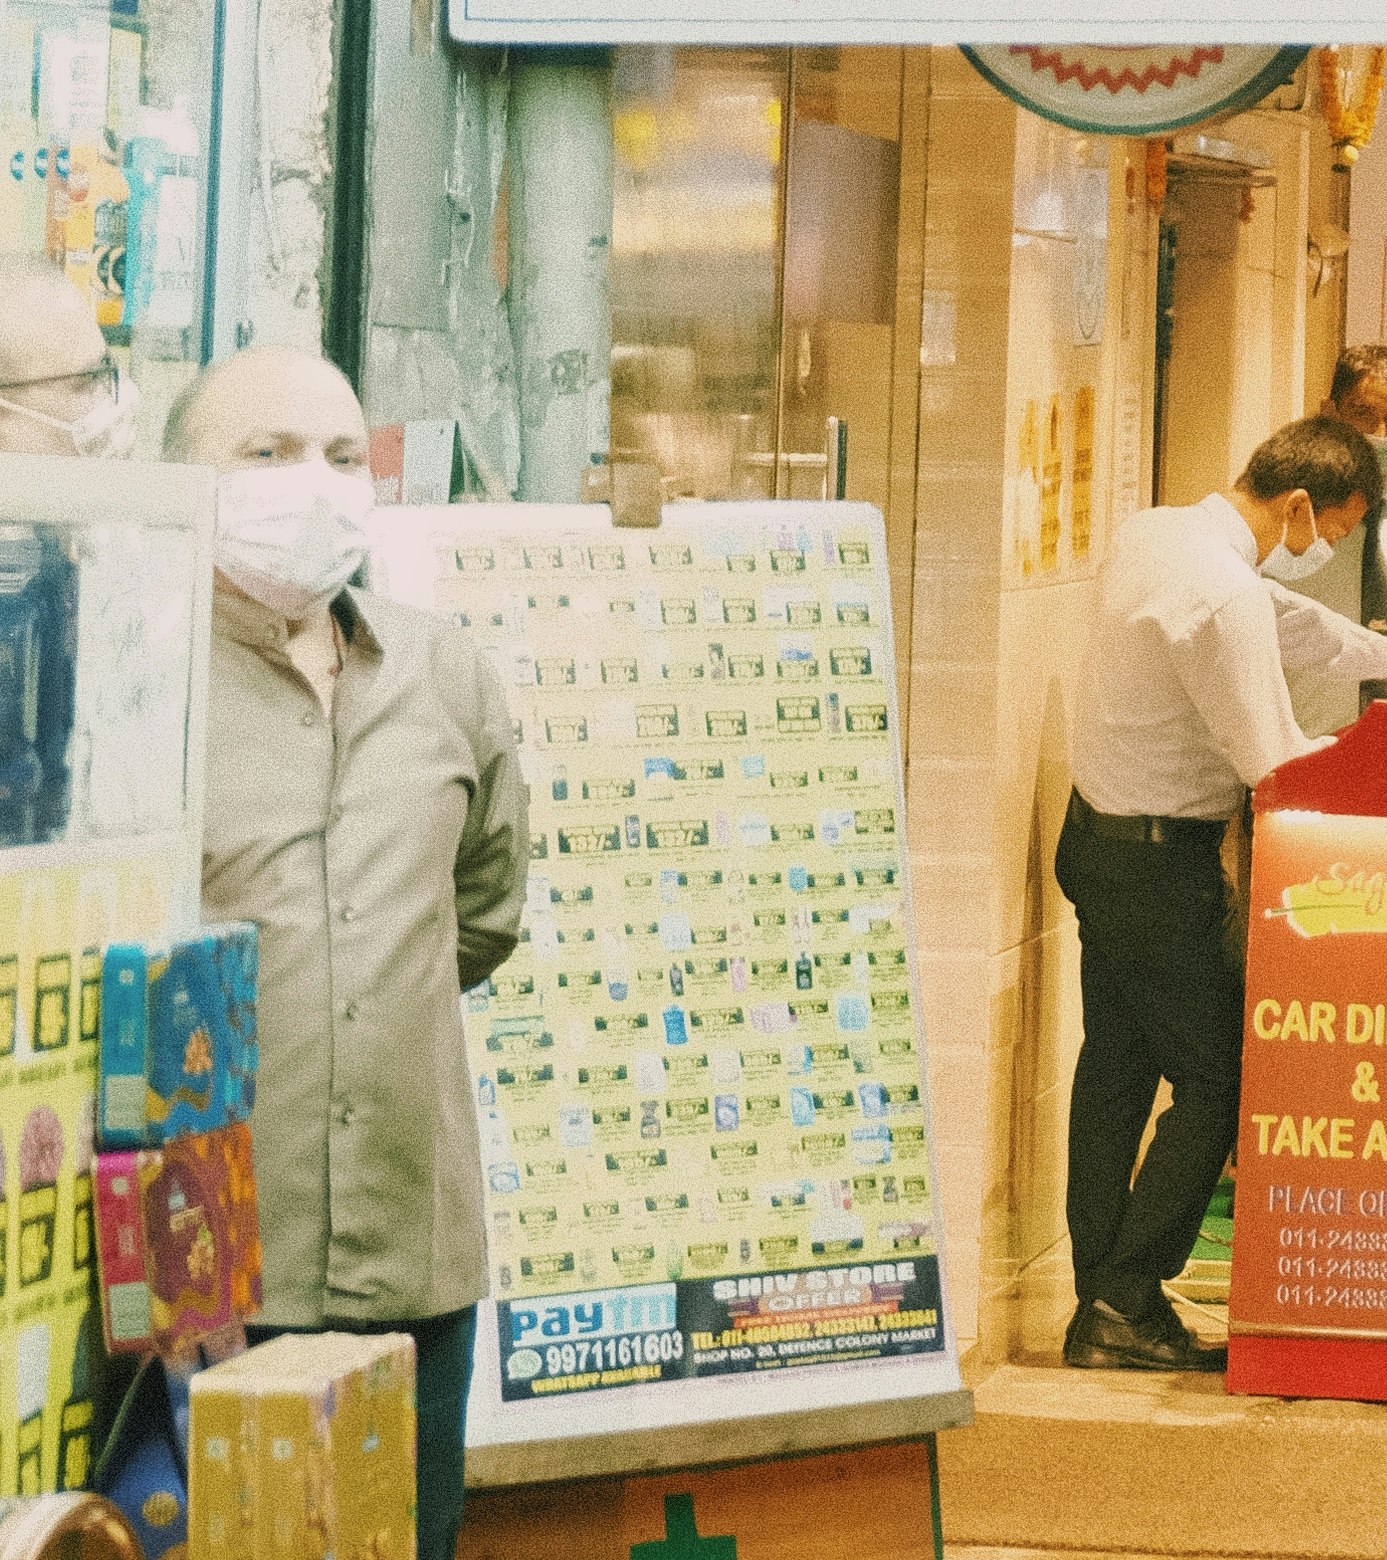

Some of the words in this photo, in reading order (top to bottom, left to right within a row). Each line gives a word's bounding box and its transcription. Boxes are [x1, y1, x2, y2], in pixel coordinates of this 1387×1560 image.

[1252, 998, 1336, 1044] CAR
[1350, 1060, 1381, 1104] &
[1251, 1114, 1354, 1160] TAKE
[1268, 1184, 1349, 1217] PLACE
[713, 1273, 799, 1301] SHIV
[806, 1262, 916, 1289] STORE
[768, 1288, 862, 1312] OFFER
[546, 1330, 684, 1376] 9971161603
[778, 1339, 832, 1357] DEFENCE
[835, 1333, 890, 1349] COLONY
[892, 1327, 936, 1343] MARKET
